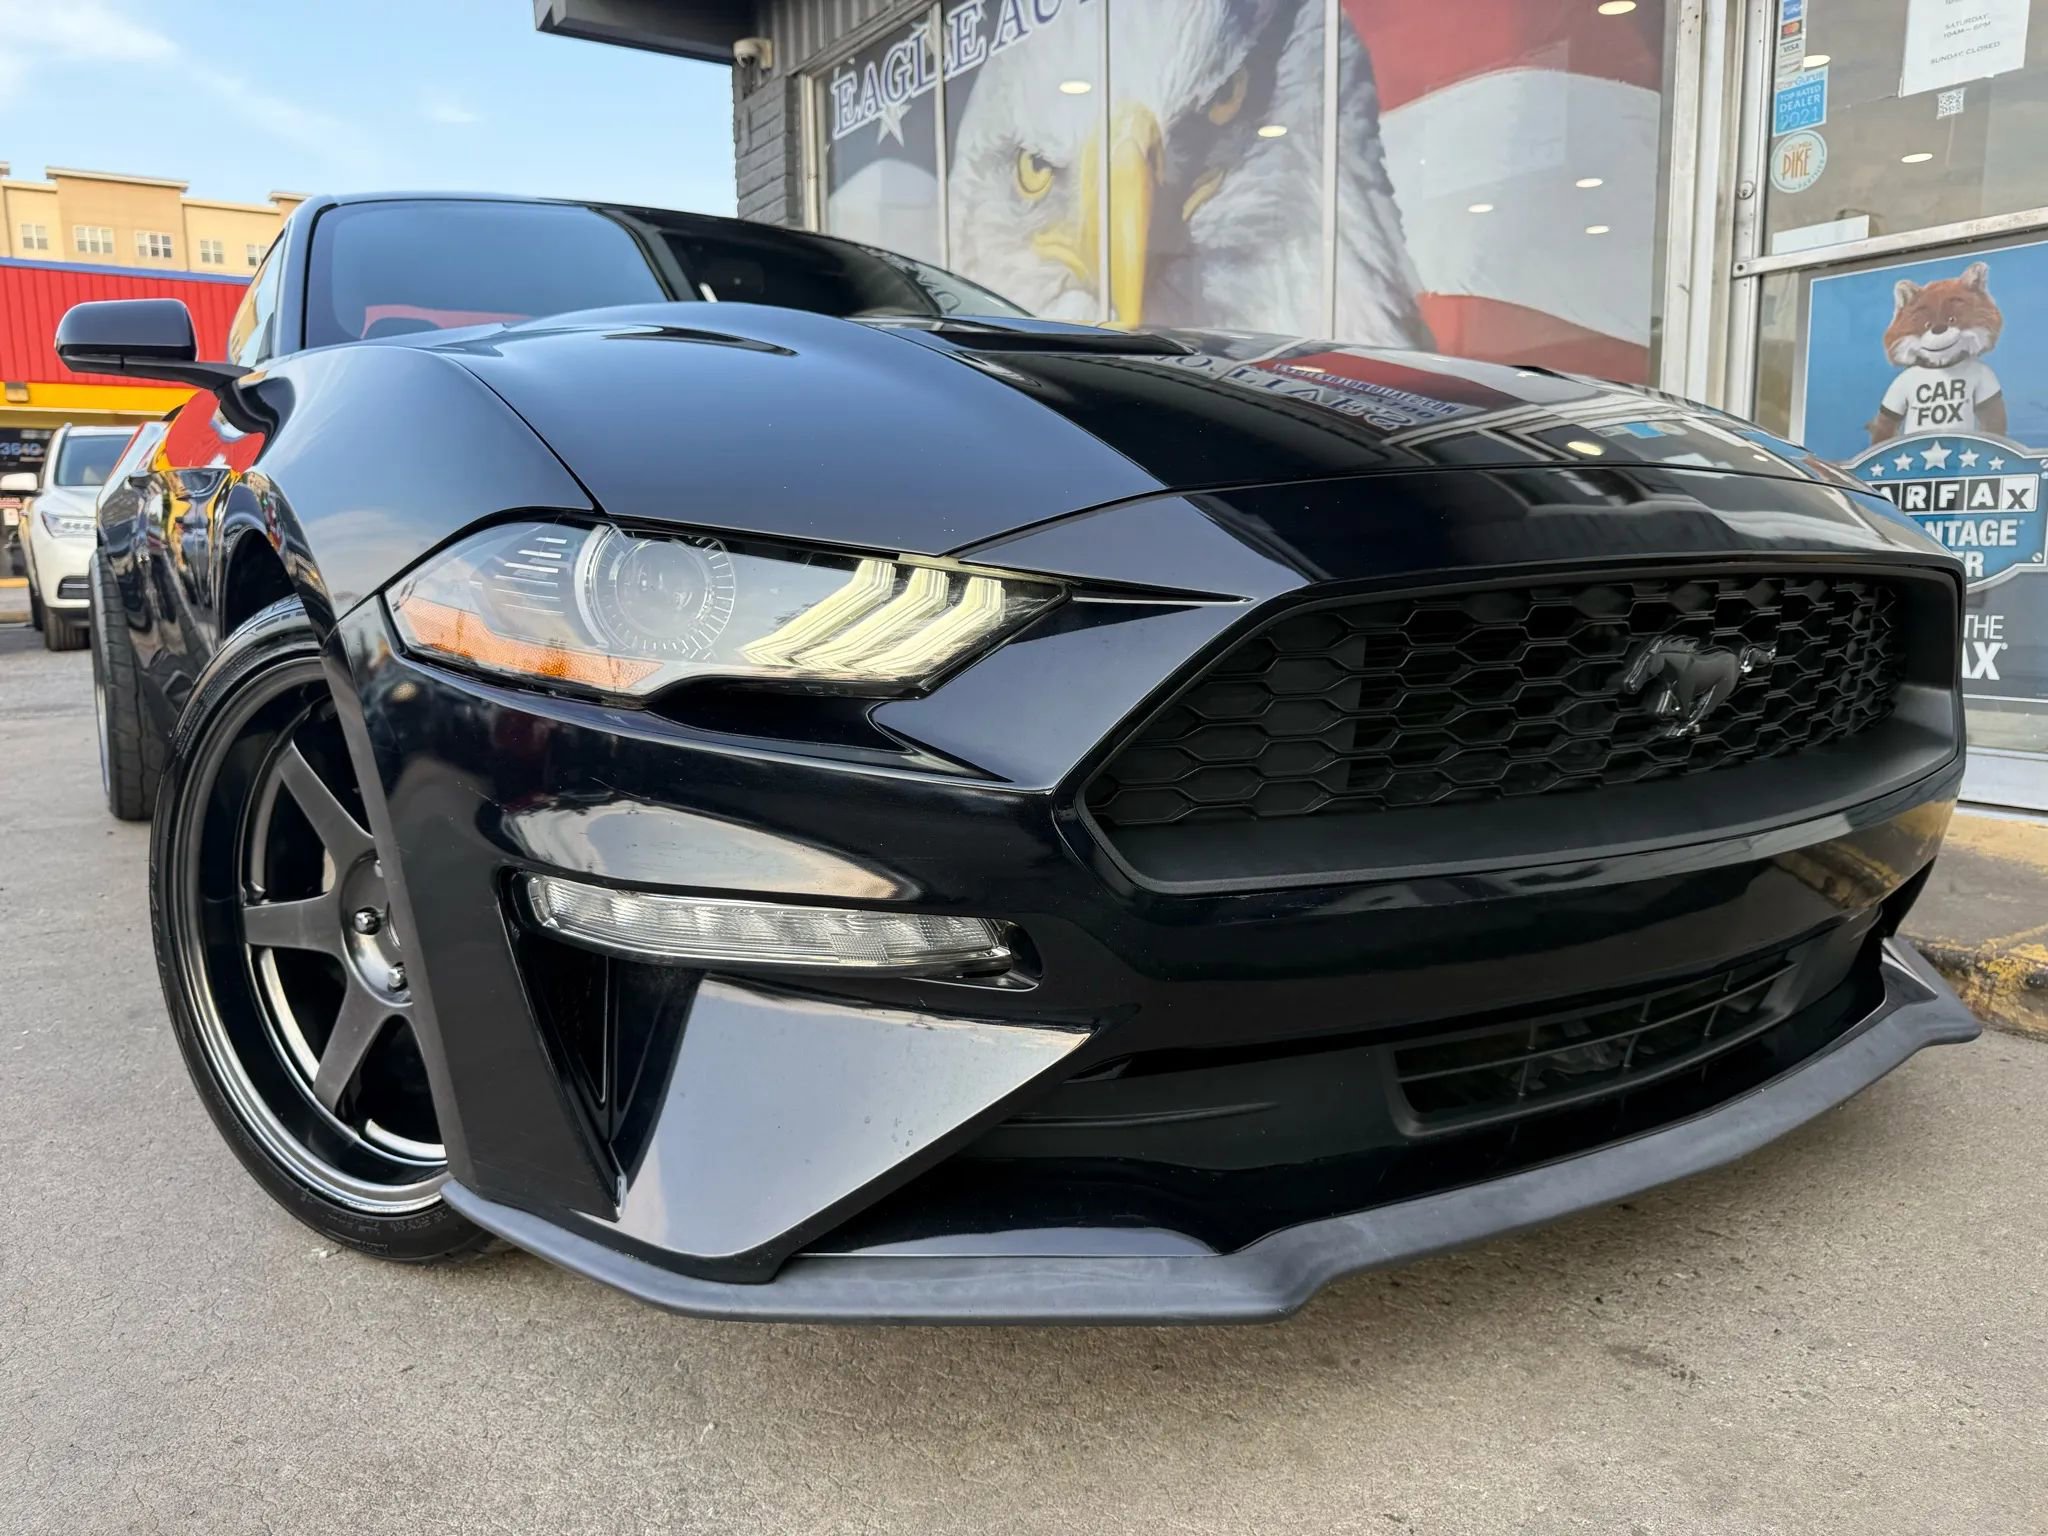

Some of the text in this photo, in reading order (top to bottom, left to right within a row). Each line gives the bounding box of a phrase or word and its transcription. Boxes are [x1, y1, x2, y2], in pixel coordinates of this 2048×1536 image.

[1965, 41, 2001, 55] CLOSED
[831, 0, 987, 140] EAGLE
[1779, 94, 1821, 113] DEALER
[1796, 84, 1821, 98] RATED
[1779, 105, 1819, 130] 2021
[1781, 147, 1812, 181] PIKE
[1916, 379, 1966, 404] CAR
[1917, 402, 1965, 427] FOX
[1880, 483, 2032, 511] RFAX
[1925, 519, 2018, 548] NTAGE
[1963, 614, 2005, 640] THE
